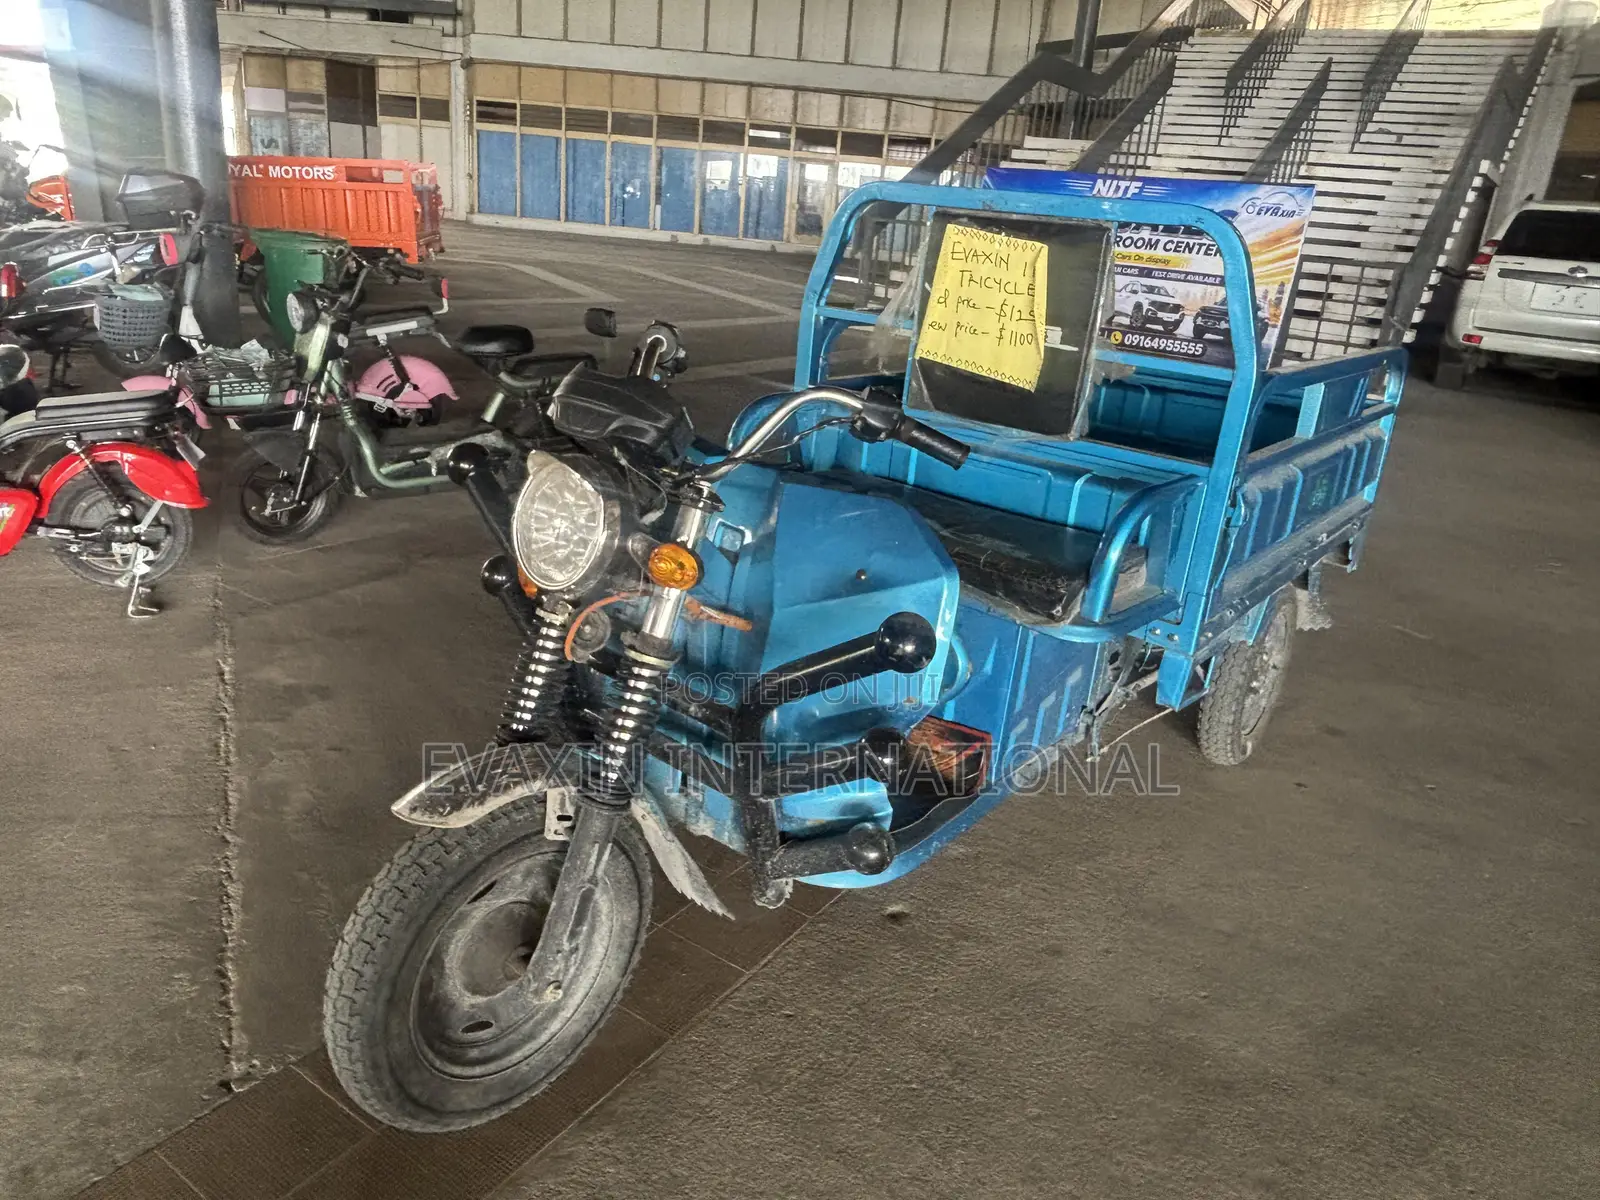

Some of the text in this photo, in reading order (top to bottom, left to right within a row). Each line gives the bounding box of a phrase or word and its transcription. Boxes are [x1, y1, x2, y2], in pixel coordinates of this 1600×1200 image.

[268, 165, 335, 180] MOTORS
[1091, 178, 1143, 198] NITF
[951, 241, 1010, 271] EVAXIN
[1145, 257, 1172, 266] display
[959, 269, 1036, 297] TRICYCLE
[955, 321, 979, 338] price
[1124, 333, 1204, 355] 09164955555
